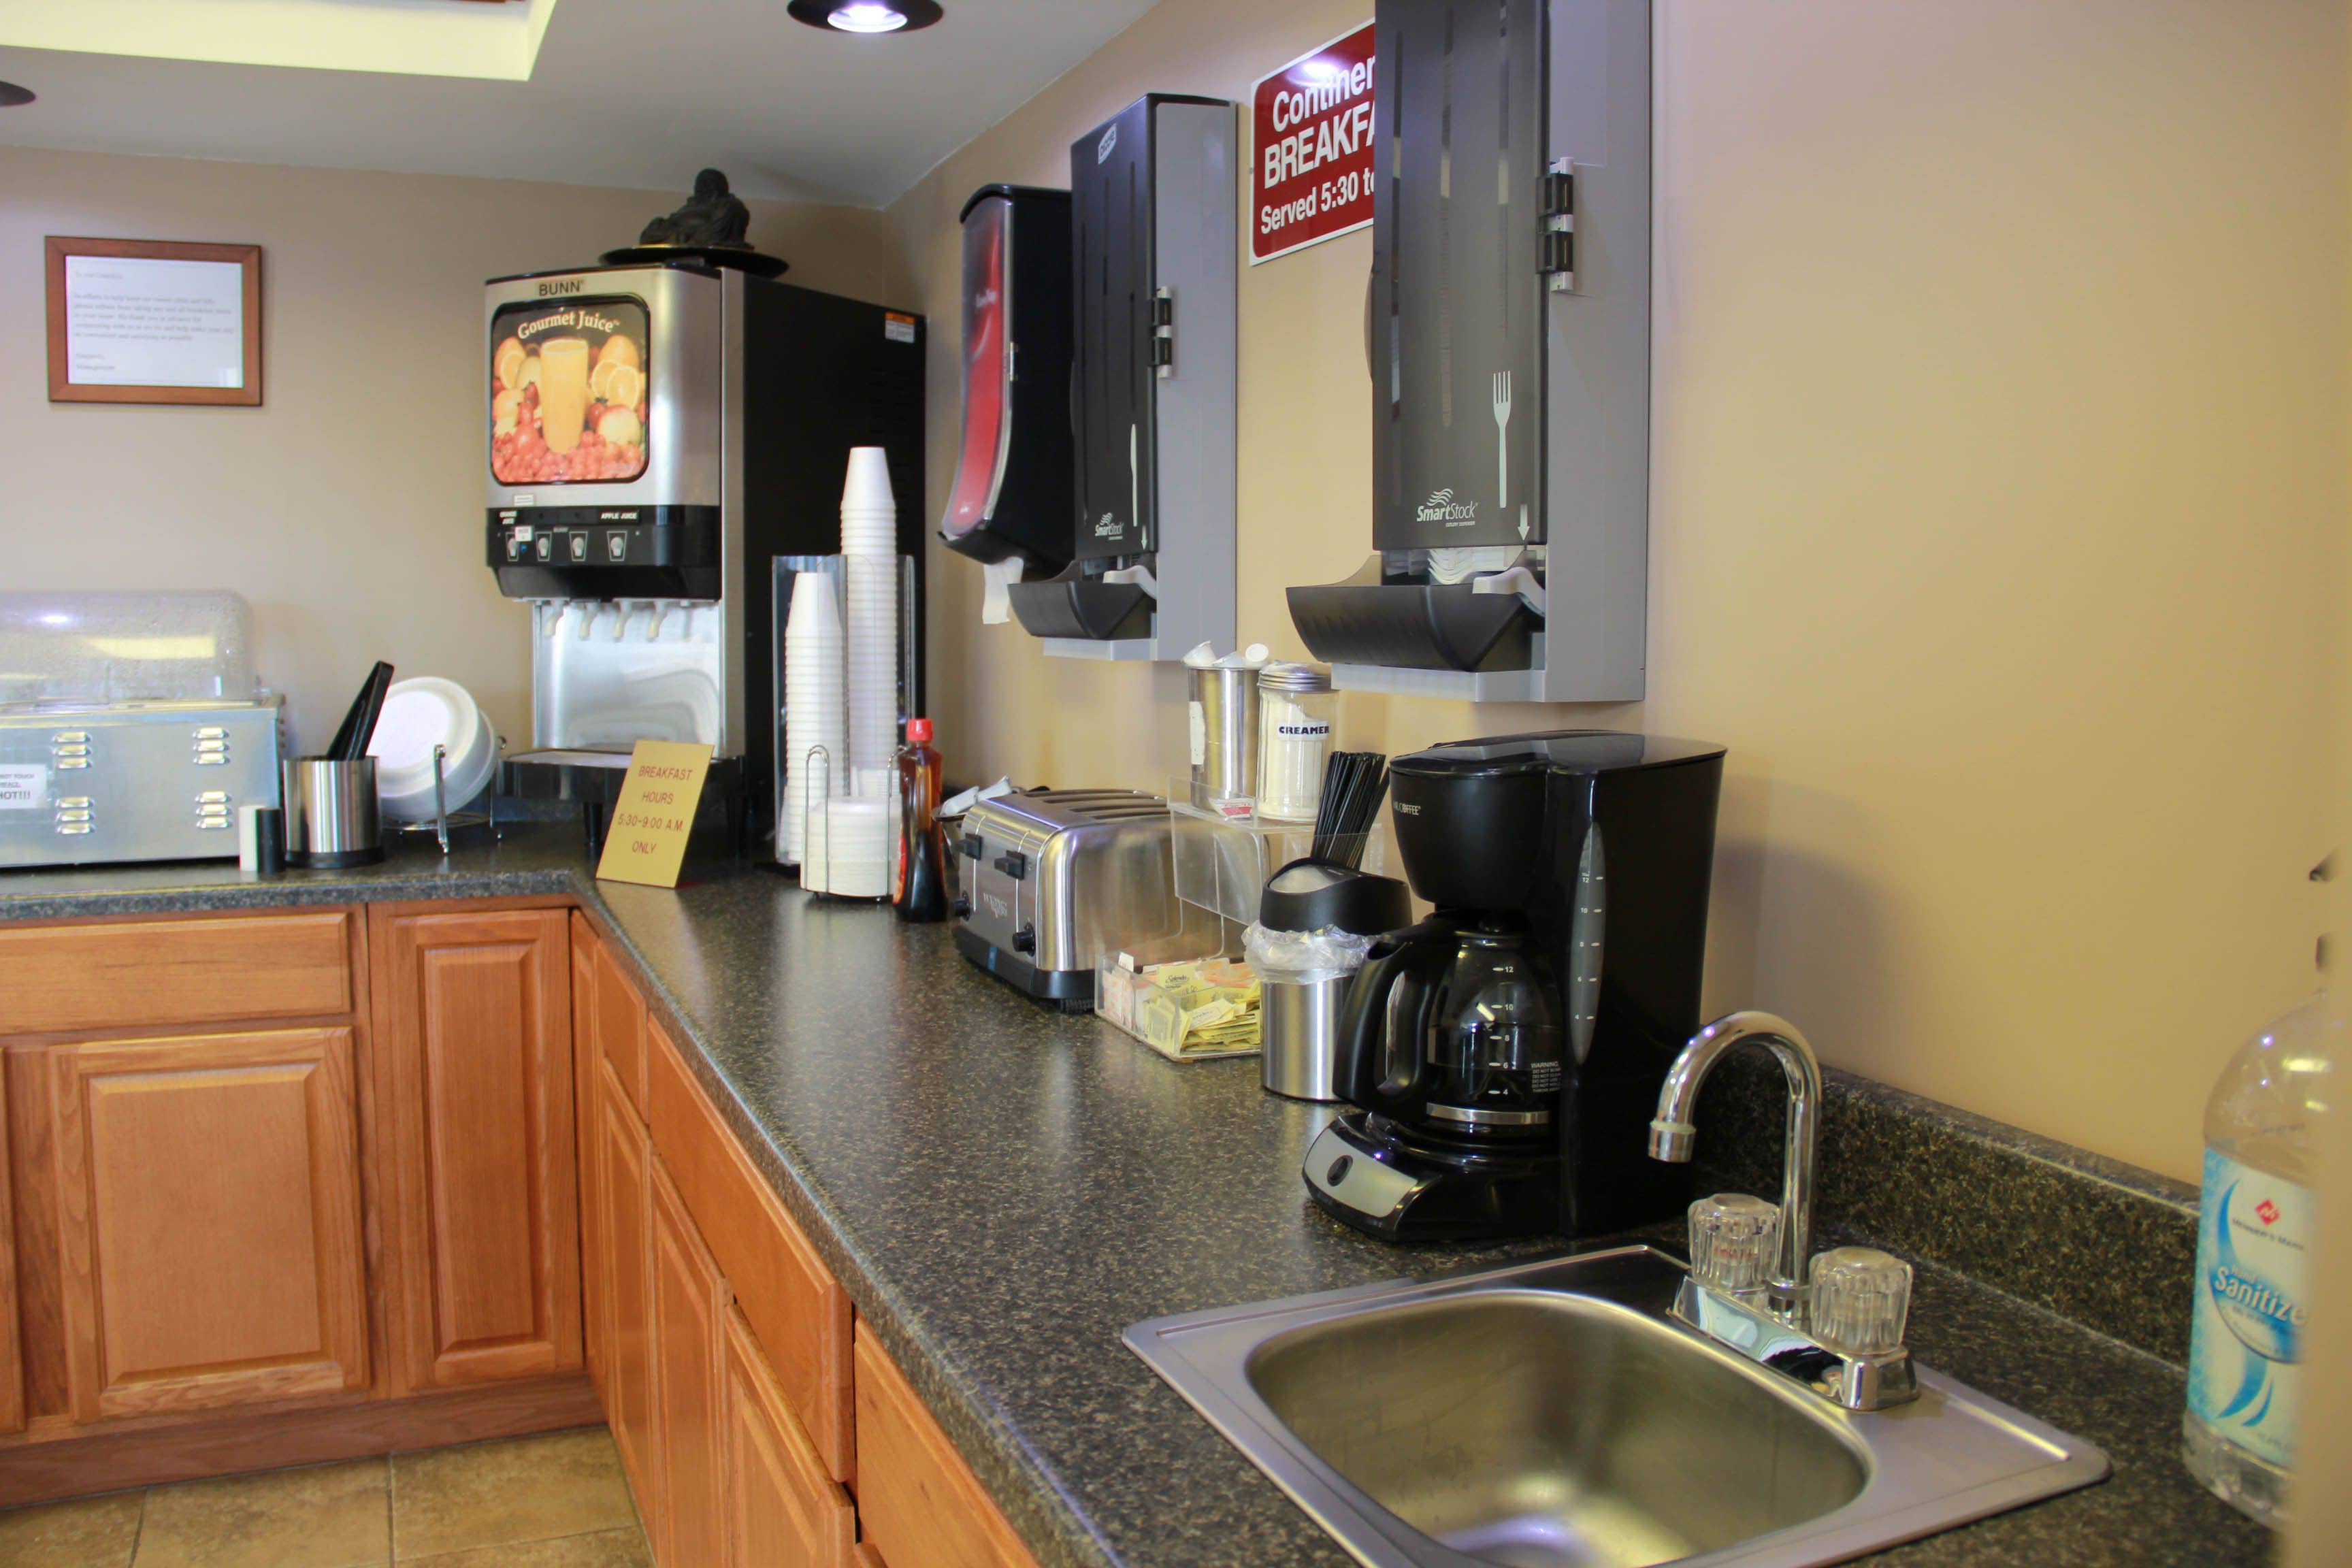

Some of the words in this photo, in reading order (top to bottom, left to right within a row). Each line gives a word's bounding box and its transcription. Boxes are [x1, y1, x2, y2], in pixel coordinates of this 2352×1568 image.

[1261, 186, 1317, 234] Served
[1320, 172, 1358, 212] 5:30
[539, 281, 581, 296] BUNN
[517, 311, 575, 339] Gourmet
[1416, 500, 1476, 522] SmartStock
[638, 766, 693, 781] BREAKFAST
[642, 791, 674, 804] HOURS
[632, 840, 657, 854] ONLY
